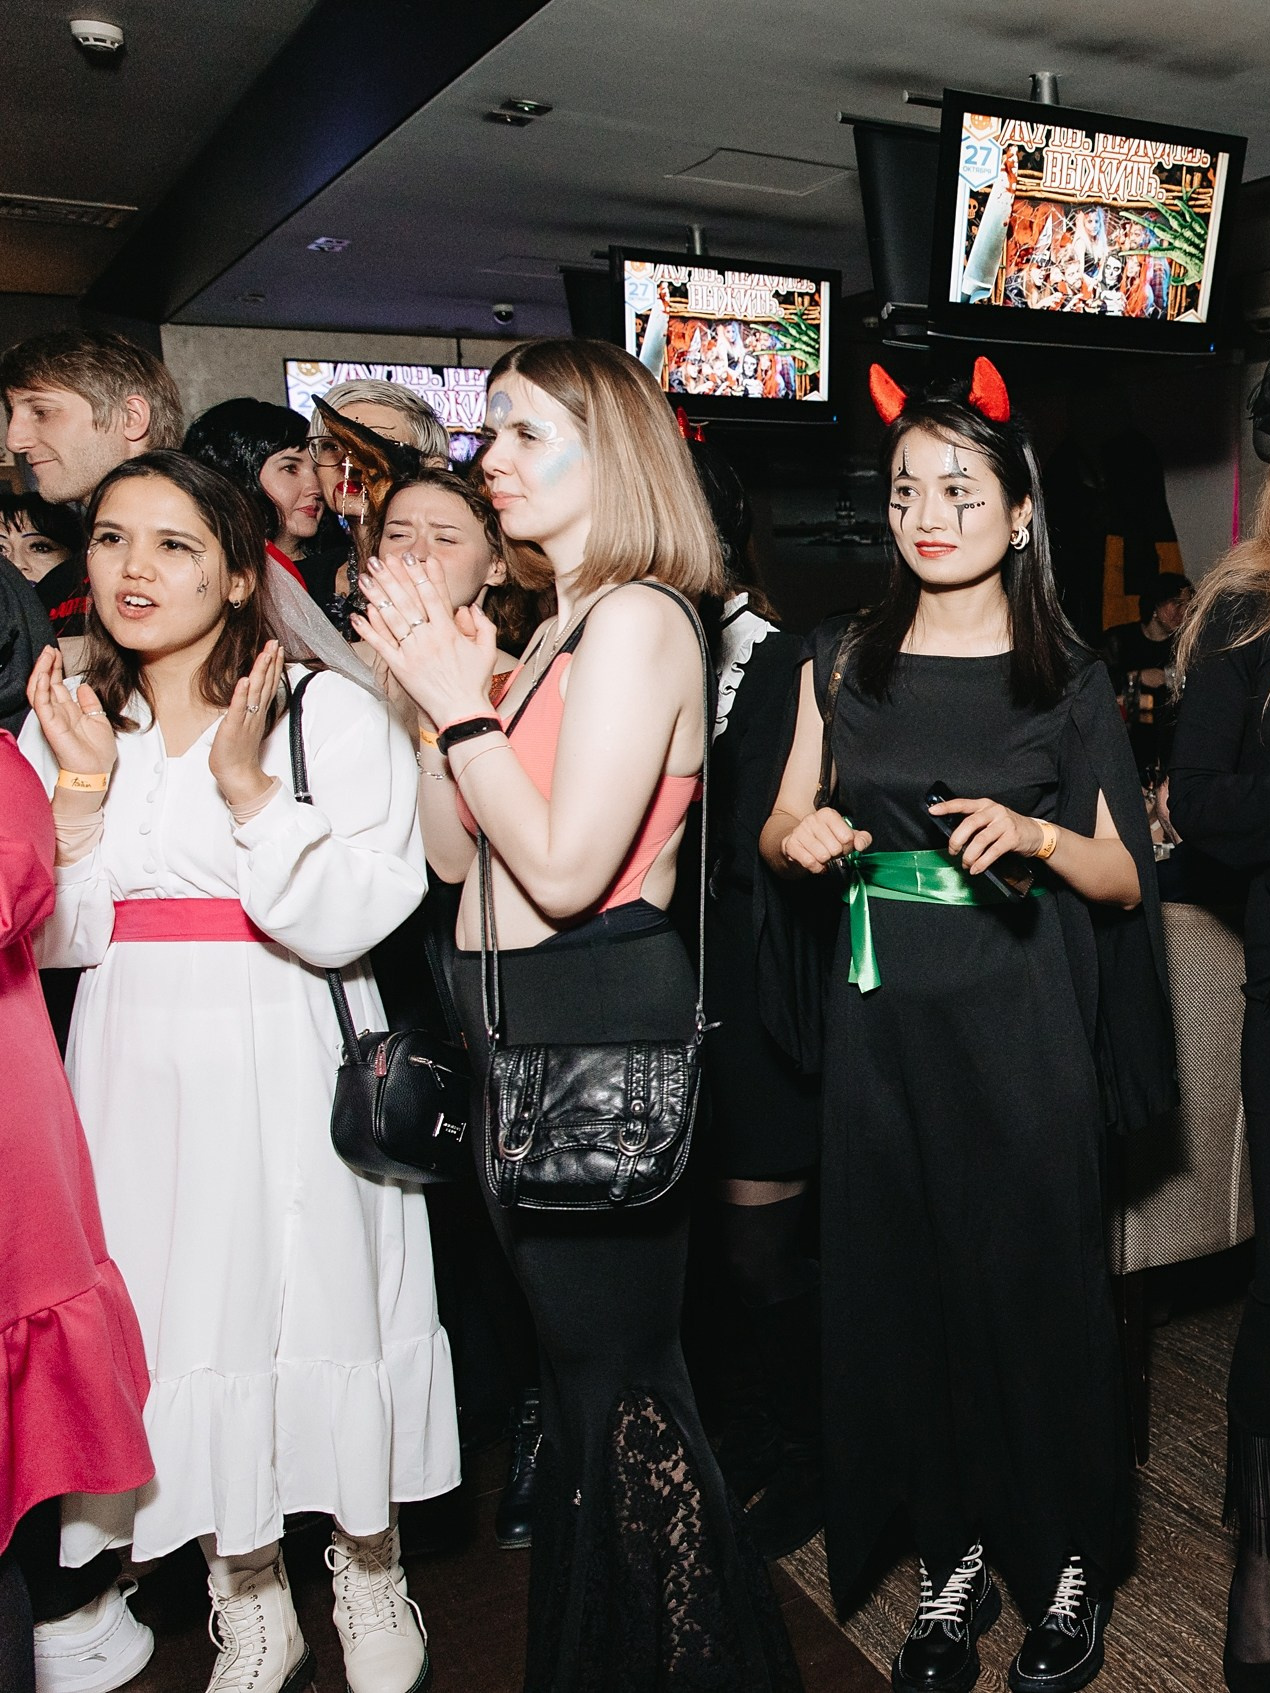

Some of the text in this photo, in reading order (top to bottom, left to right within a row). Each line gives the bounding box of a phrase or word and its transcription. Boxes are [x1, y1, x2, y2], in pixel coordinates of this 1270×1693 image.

[964, 144, 993, 166] 27
[1043, 150, 1166, 201] ВЫЖИТЬ.
[629, 282, 649, 296] 27
